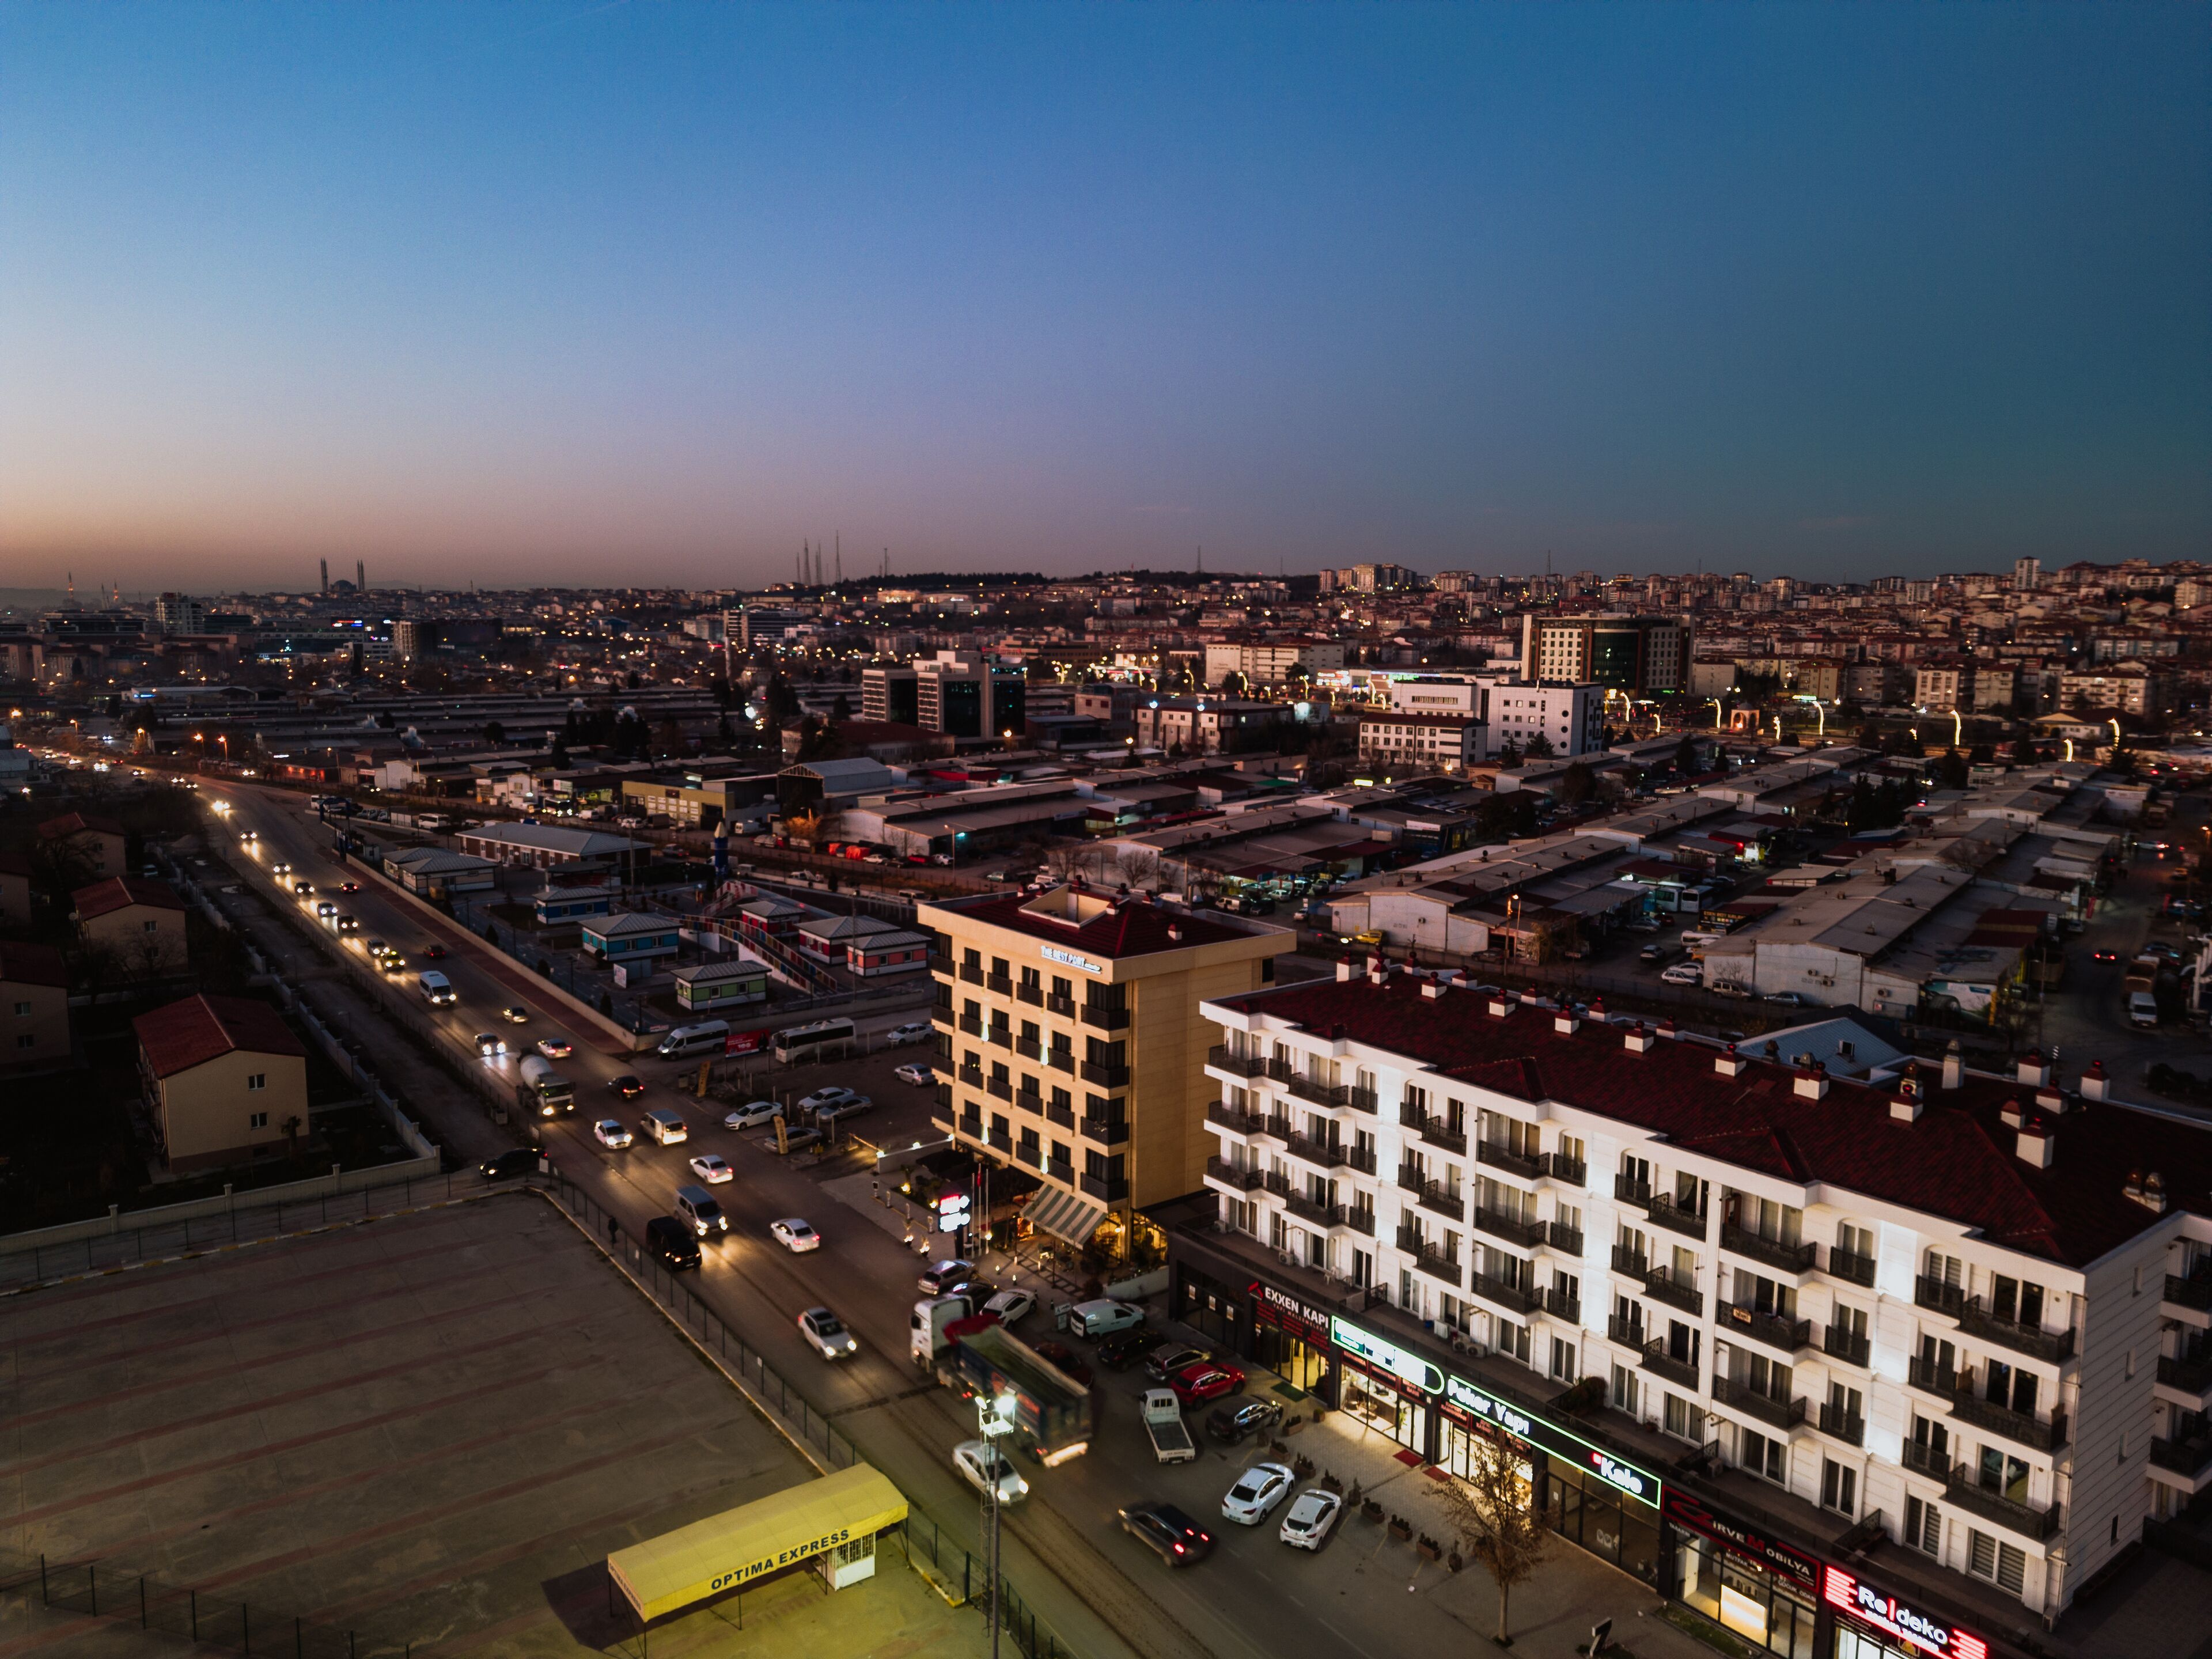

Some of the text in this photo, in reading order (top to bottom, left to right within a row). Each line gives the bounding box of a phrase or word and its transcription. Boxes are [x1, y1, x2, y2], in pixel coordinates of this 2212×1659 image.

[1265, 1287, 1298, 1313] EXXEN
[1303, 1305, 1329, 1328] KAPI
[1601, 1456, 1643, 1494] Kale
[711, 1529, 850, 1590] OPTIMA EXPRESS
